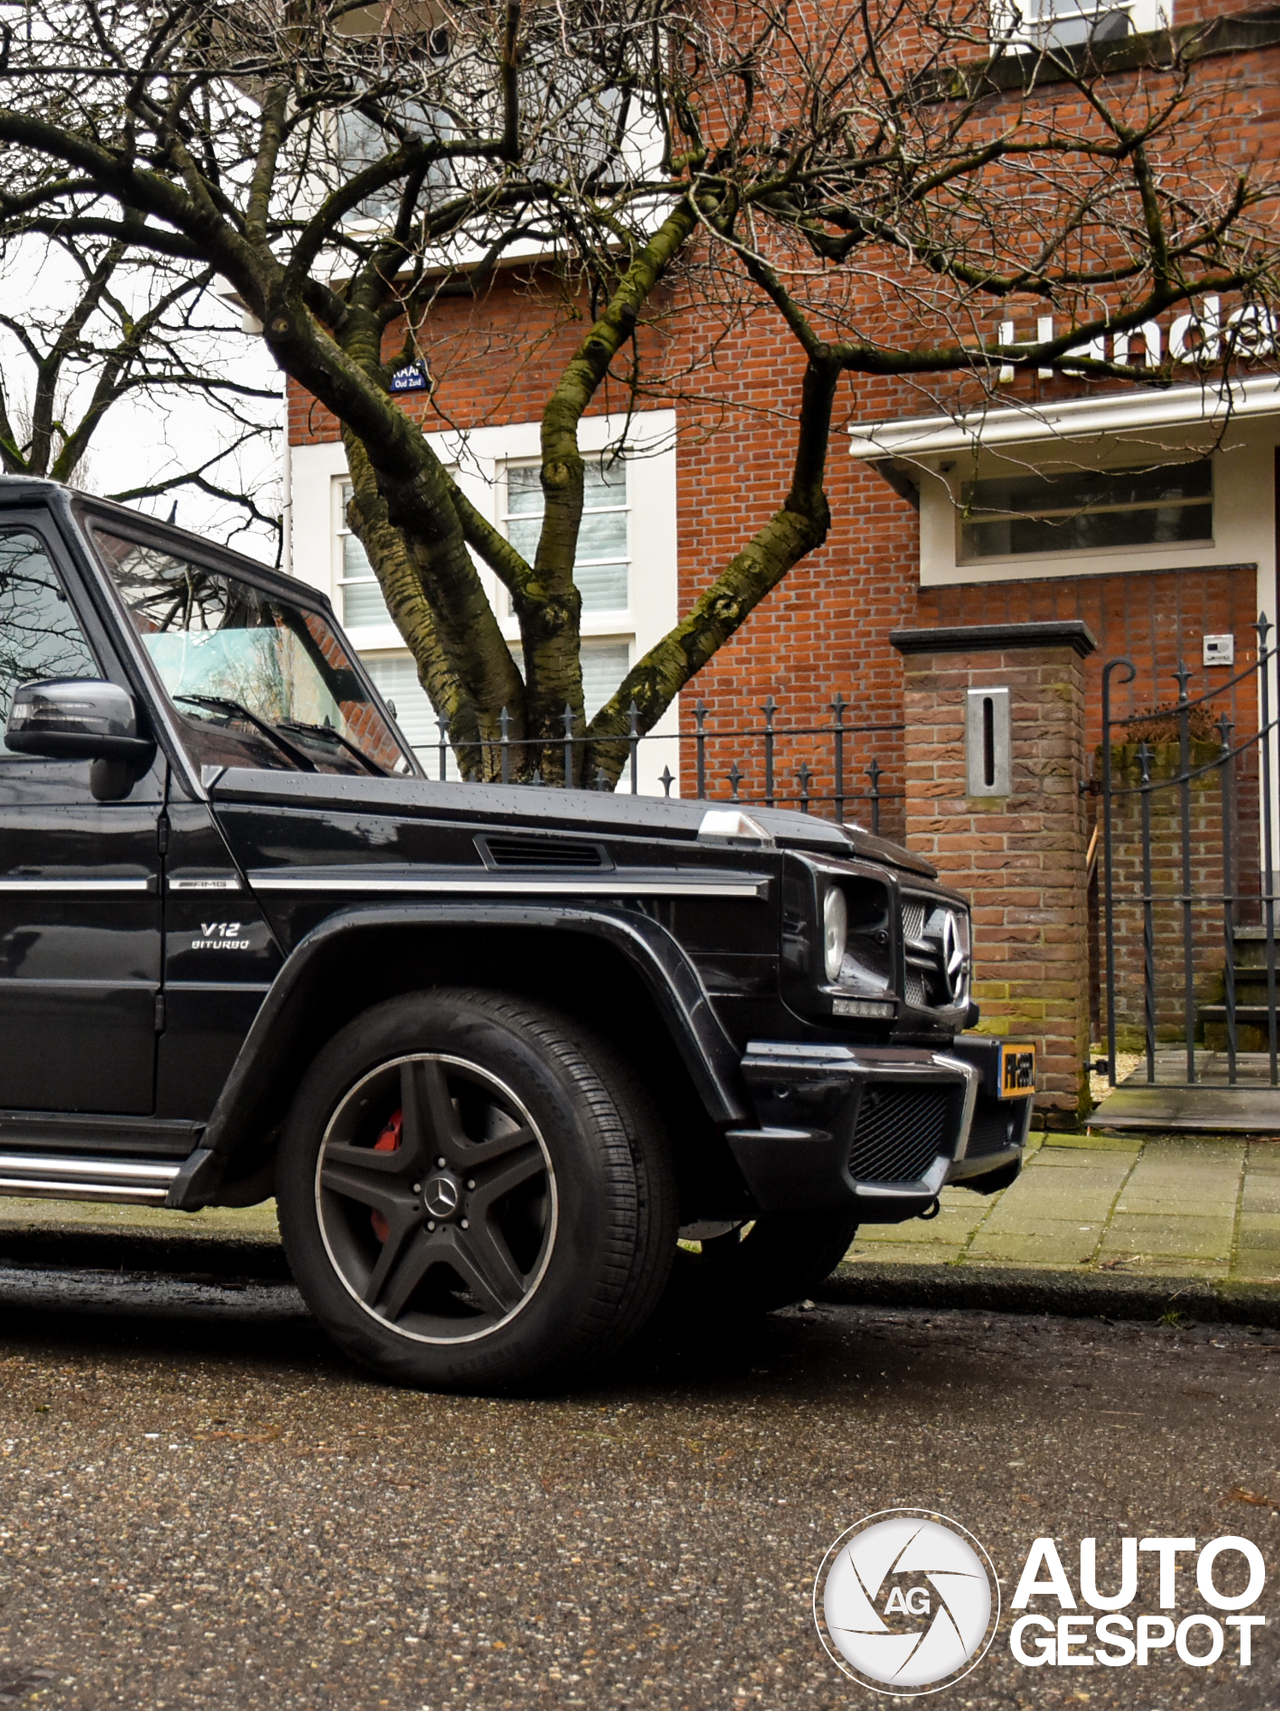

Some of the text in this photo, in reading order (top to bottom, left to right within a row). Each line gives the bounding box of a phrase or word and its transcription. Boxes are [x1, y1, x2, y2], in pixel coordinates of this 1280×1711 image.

[394, 378, 422, 388] Oud Zuid
[200, 922, 241, 937] V12
[191, 940, 250, 949] BITURBO
